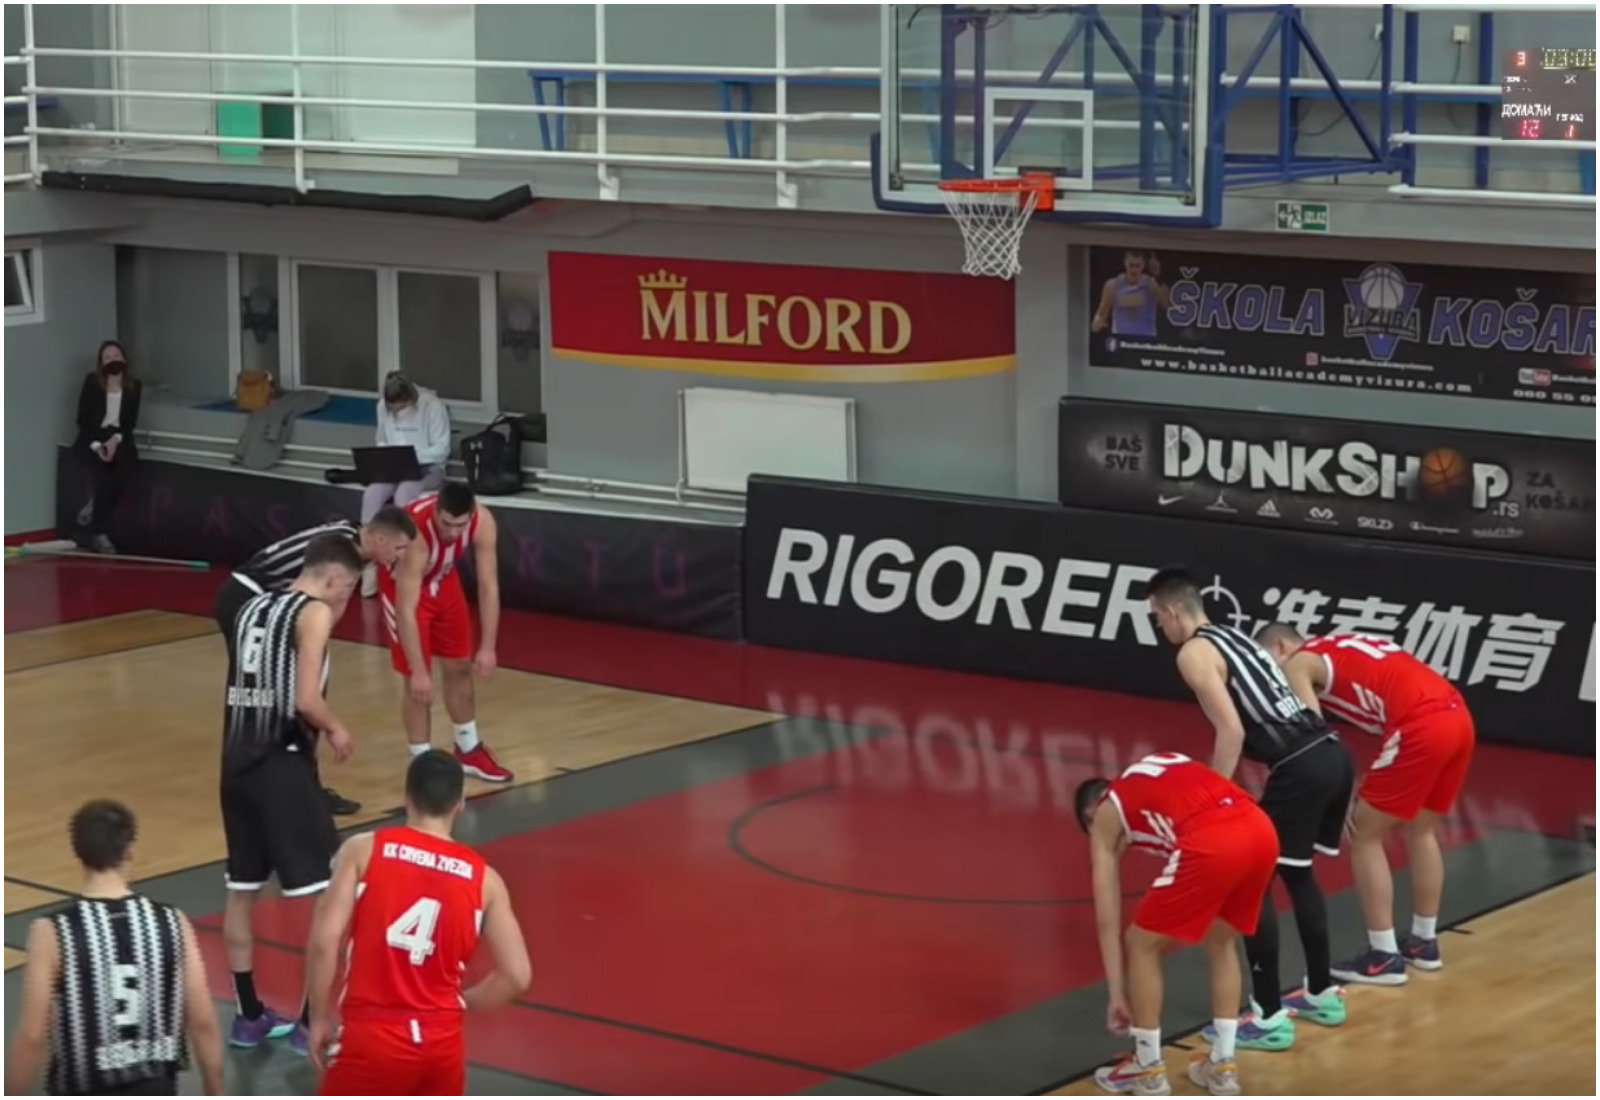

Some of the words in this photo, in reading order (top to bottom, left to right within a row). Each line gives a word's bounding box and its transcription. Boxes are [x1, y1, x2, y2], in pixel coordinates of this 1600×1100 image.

[640, 289, 912, 356] MILFORD
[1167, 266, 1325, 337] ŠKOLA
[1140, 357, 1473, 393] www.basketballacademyvizura.com
[1104, 453, 1140, 472] SVE
[1105, 434, 1143, 452] BAŠ
[242, 625, 267, 674] 6
[385, 896, 442, 966] 4
[110, 963, 141, 1026] 5
